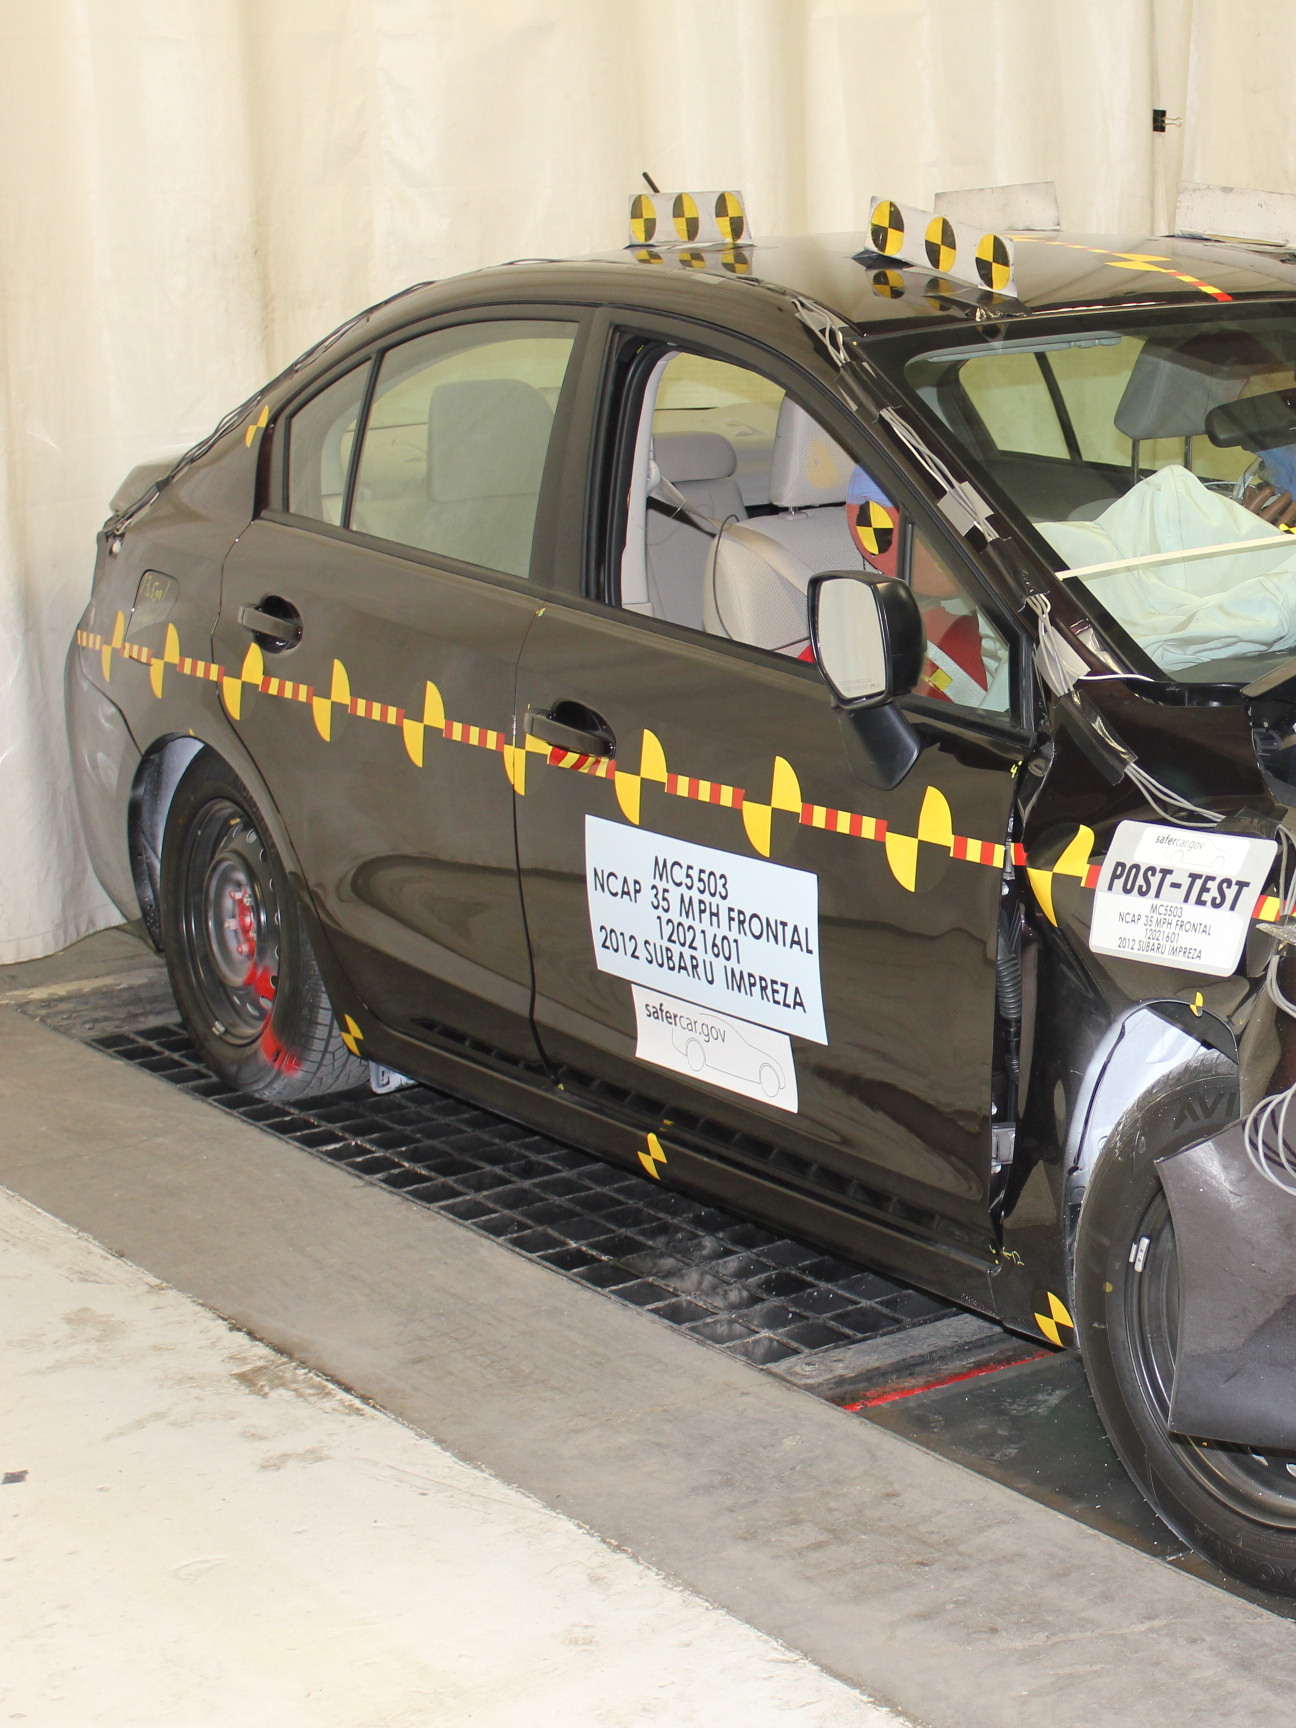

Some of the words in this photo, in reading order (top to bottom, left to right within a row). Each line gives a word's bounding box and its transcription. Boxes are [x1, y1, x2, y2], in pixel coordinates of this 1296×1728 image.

[1155, 834, 1206, 852] safercar.gov
[653, 855, 730, 900] MC5503
[1107, 861, 1251, 912] POST-TEST
[593, 866, 643, 904] NCAP
[650, 884, 671, 913] 35
[679, 893, 721, 932] MPH
[727, 906, 814, 954] FRONTAL
[1118, 911, 1142, 926] NCAP
[1143, 915, 1153, 927] 35
[1155, 916, 1173, 930] MPH
[1175, 920, 1212, 937] FRONTAL
[1150, 904, 1184, 918] MC5503
[656, 915, 741, 964] 12021601
[1117, 936, 1136, 951] 2012
[1137, 940, 1166, 955] SUBARU
[1167, 945, 1202, 960] IMPREZA
[1144, 929, 1180, 943] 12021601
[599, 925, 640, 960] 2012
[644, 939, 715, 985] SUBARU
[724, 964, 807, 1013] IMPREZA
[644, 1002, 726, 1044] safercar.gov
